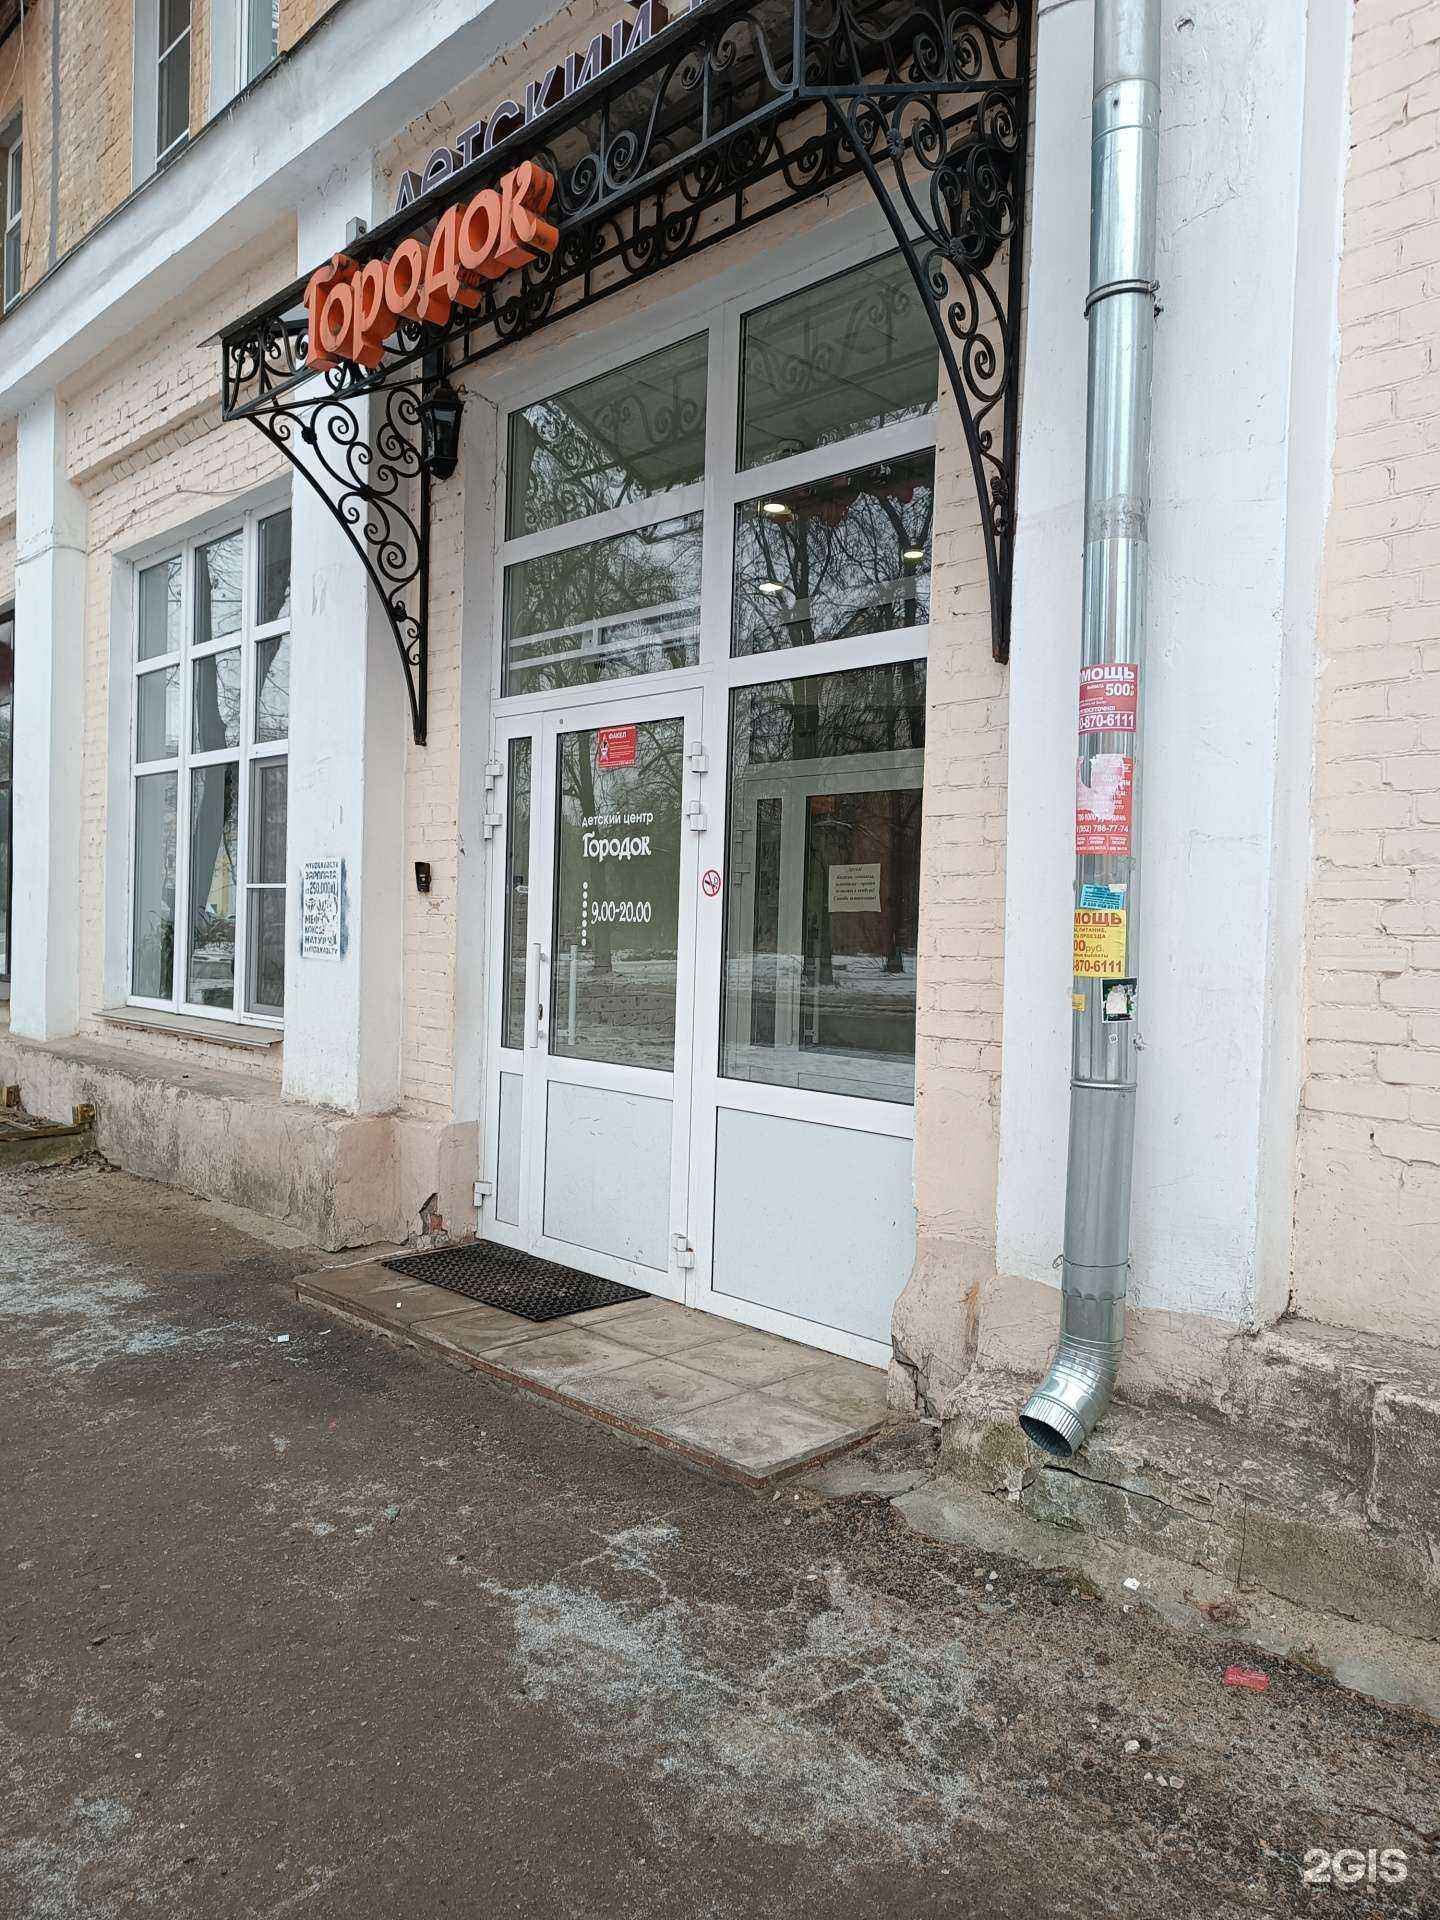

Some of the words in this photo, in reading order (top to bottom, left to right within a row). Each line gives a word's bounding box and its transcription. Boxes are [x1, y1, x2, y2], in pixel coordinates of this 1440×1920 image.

[304, 160, 559, 371] Городок
[1105, 683, 1130, 696] 500
[581, 811, 621, 827] детский
[623, 811, 654, 825] центр
[582, 831, 652, 862] Городок
[591, 901, 652, 925] 9.00-20.00
